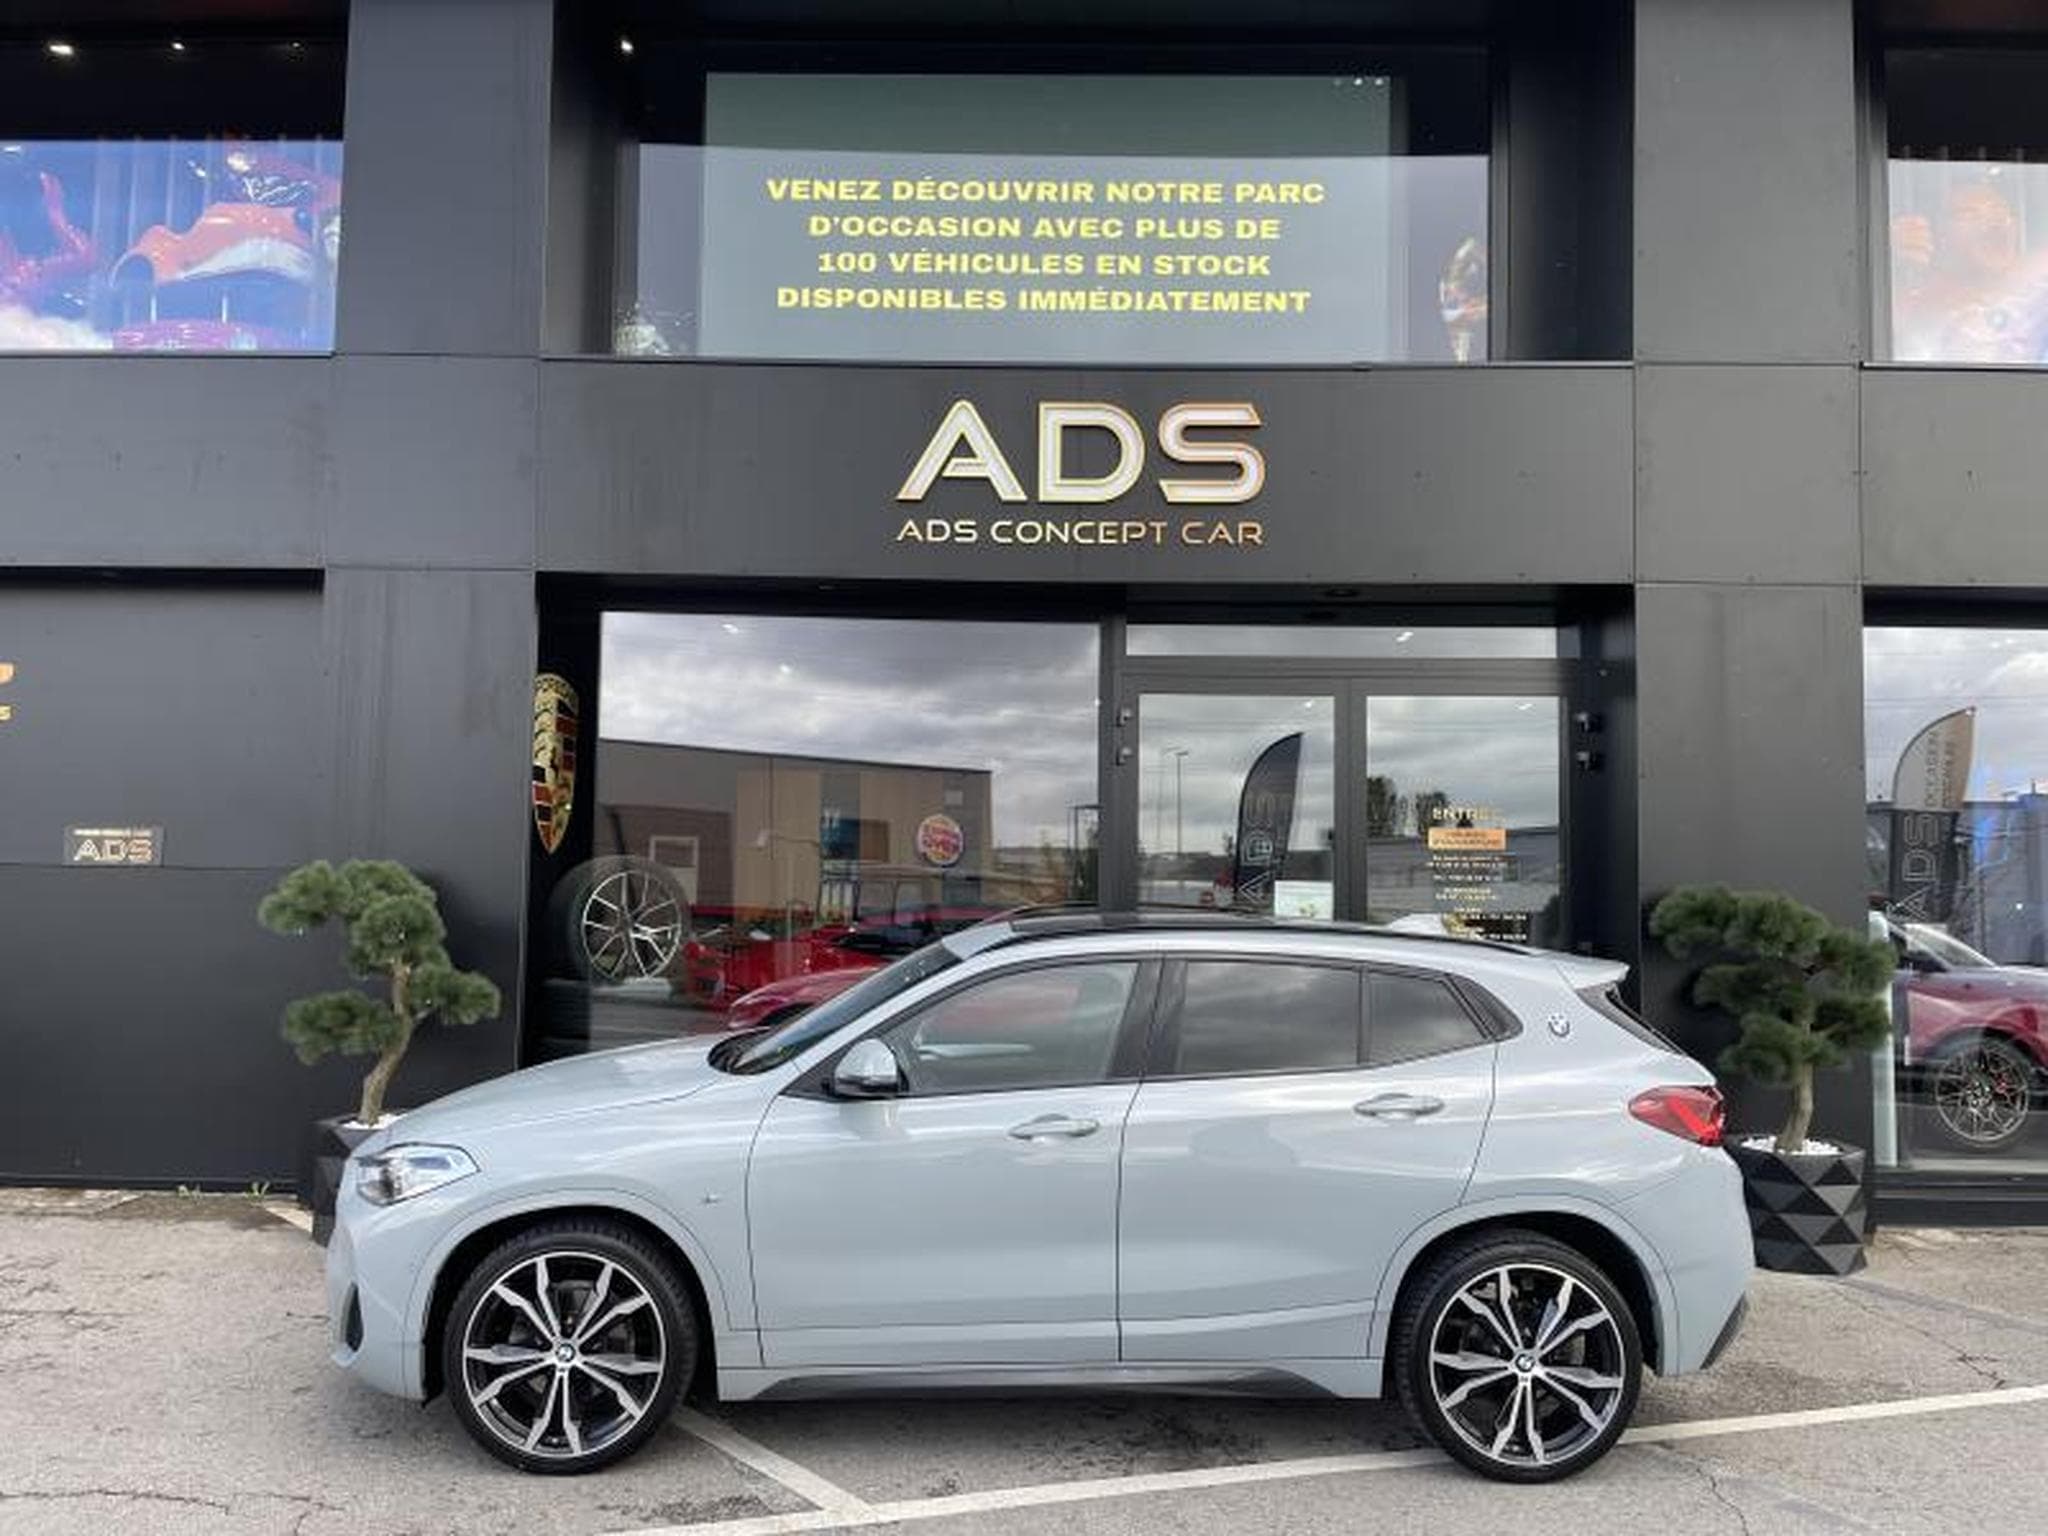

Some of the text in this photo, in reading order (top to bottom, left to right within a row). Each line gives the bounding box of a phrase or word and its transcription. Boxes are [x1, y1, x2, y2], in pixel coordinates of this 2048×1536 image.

[767, 175, 1325, 205] VENEZ DÉCOUVRIR NOTRE PARC
[808, 215, 1282, 241] D'OCCASION AVEC PLUS DE
[818, 247, 1272, 277] 100 VÉHICULES EN STOCK
[777, 286, 1313, 313] DISPONIBLES IMMÉDIATEMENT
[896, 399, 1266, 503] ADS
[896, 519, 1264, 545] ADS CONCEPT CAR
[73, 838, 152, 863] ADS
